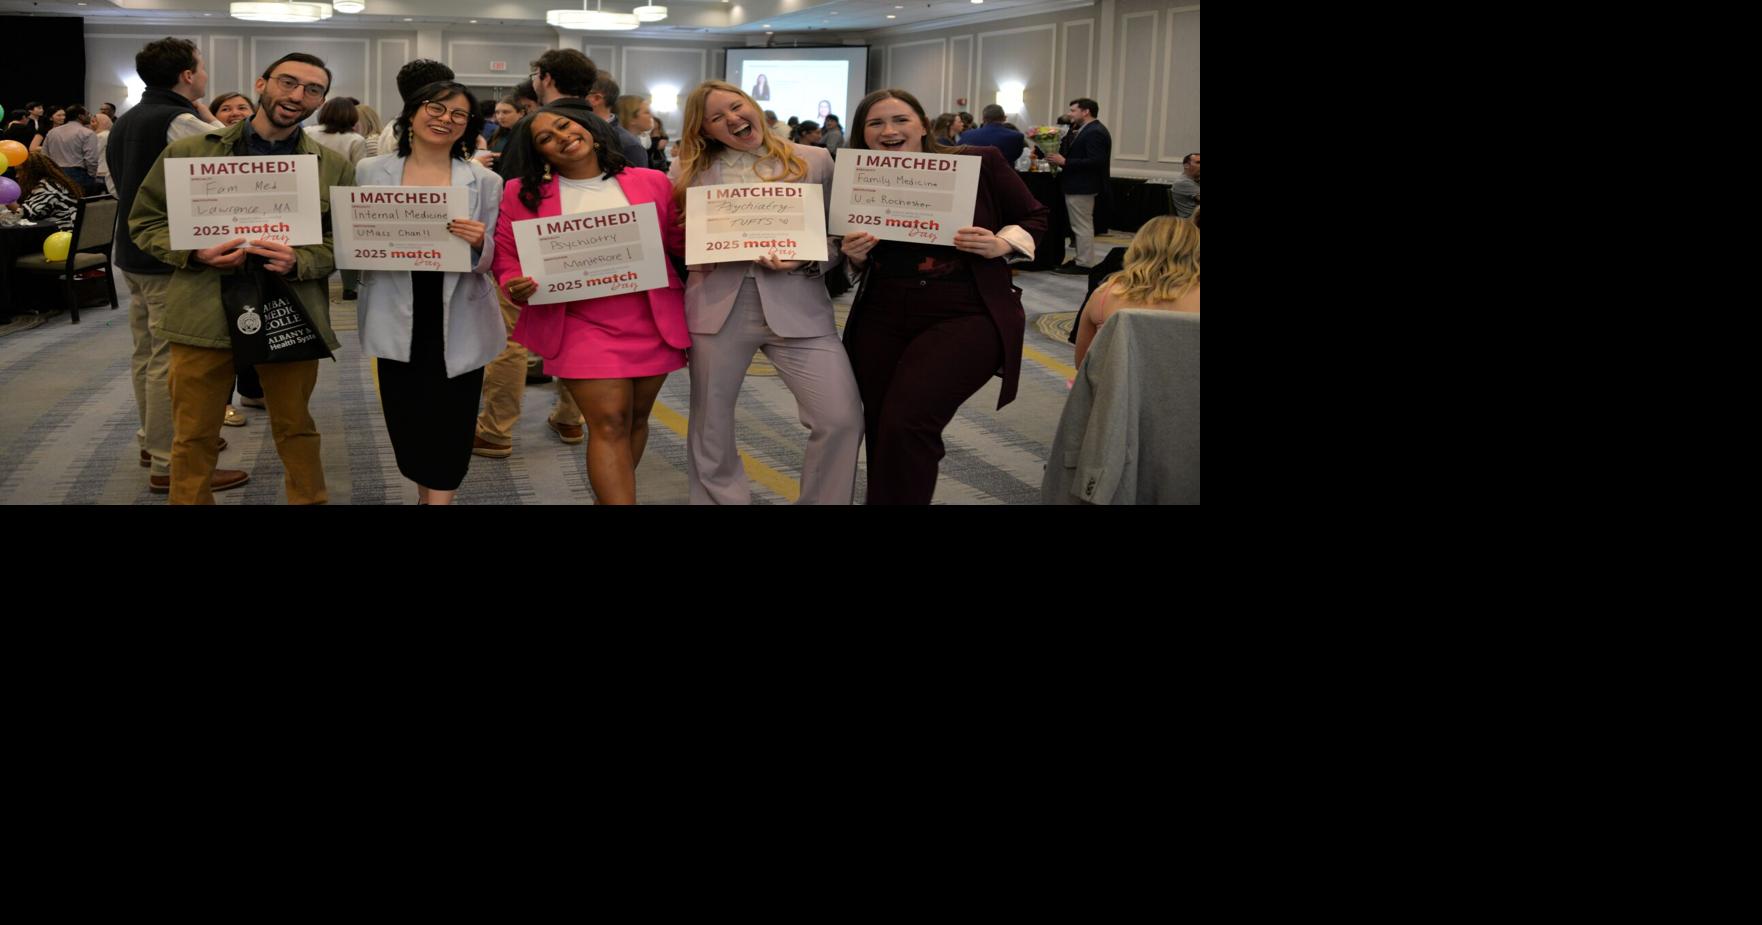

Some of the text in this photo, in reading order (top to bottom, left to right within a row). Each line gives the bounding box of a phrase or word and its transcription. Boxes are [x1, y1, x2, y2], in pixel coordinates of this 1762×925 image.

[189, 161, 296, 175] I MATCHED!
[856, 155, 957, 172] I MATCHED!
[857, 172, 938, 188] Family Medicine
[206, 181, 277, 196] Fam Med
[707, 187, 803, 200] I MATCHED!
[351, 192, 447, 204] I MATCHED!
[854, 195, 862, 203] U
[881, 195, 932, 208] Rochester
[273, 203, 291, 213] MA
[354, 209, 448, 220] Internal Medicine
[193, 222, 290, 236] 2025 match
[536, 211, 637, 236] I MATCHED!
[848, 214, 940, 231] 2025 match
[356, 229, 391, 237] UMass
[550, 233, 617, 250] Psychiatry
[706, 239, 797, 251] 2025 match
[354, 249, 441, 259] 2025 match
[548, 271, 638, 293] 2025 match
[268, 329, 304, 344] ALBANY
[270, 339, 296, 351] Health
